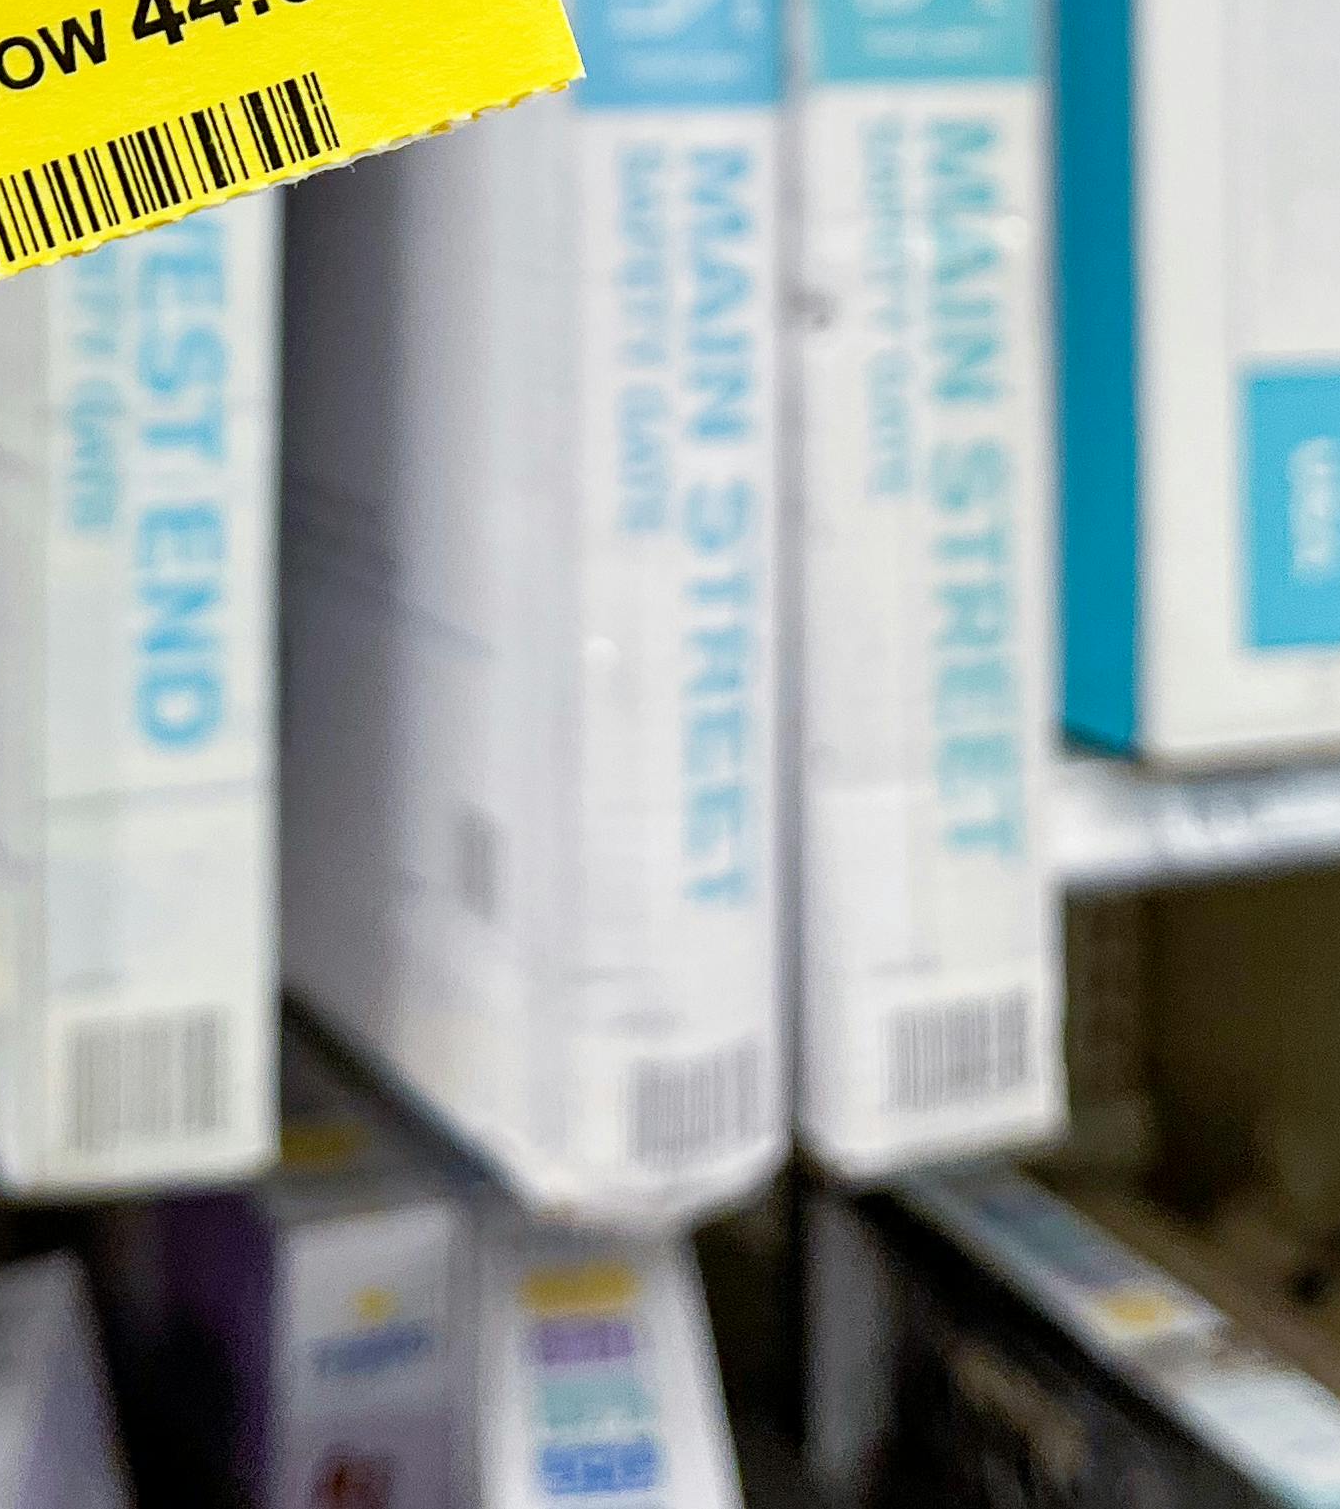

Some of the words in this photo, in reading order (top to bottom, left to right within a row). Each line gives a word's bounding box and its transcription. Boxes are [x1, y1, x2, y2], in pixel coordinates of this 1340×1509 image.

[137, 216, 229, 459] EST
[687, 144, 757, 442] MAIN
[929, 114, 1005, 404] MAIN
[137, 500, 229, 752] END
[681, 480, 757, 910] STREET
[932, 440, 1026, 860] STREET
